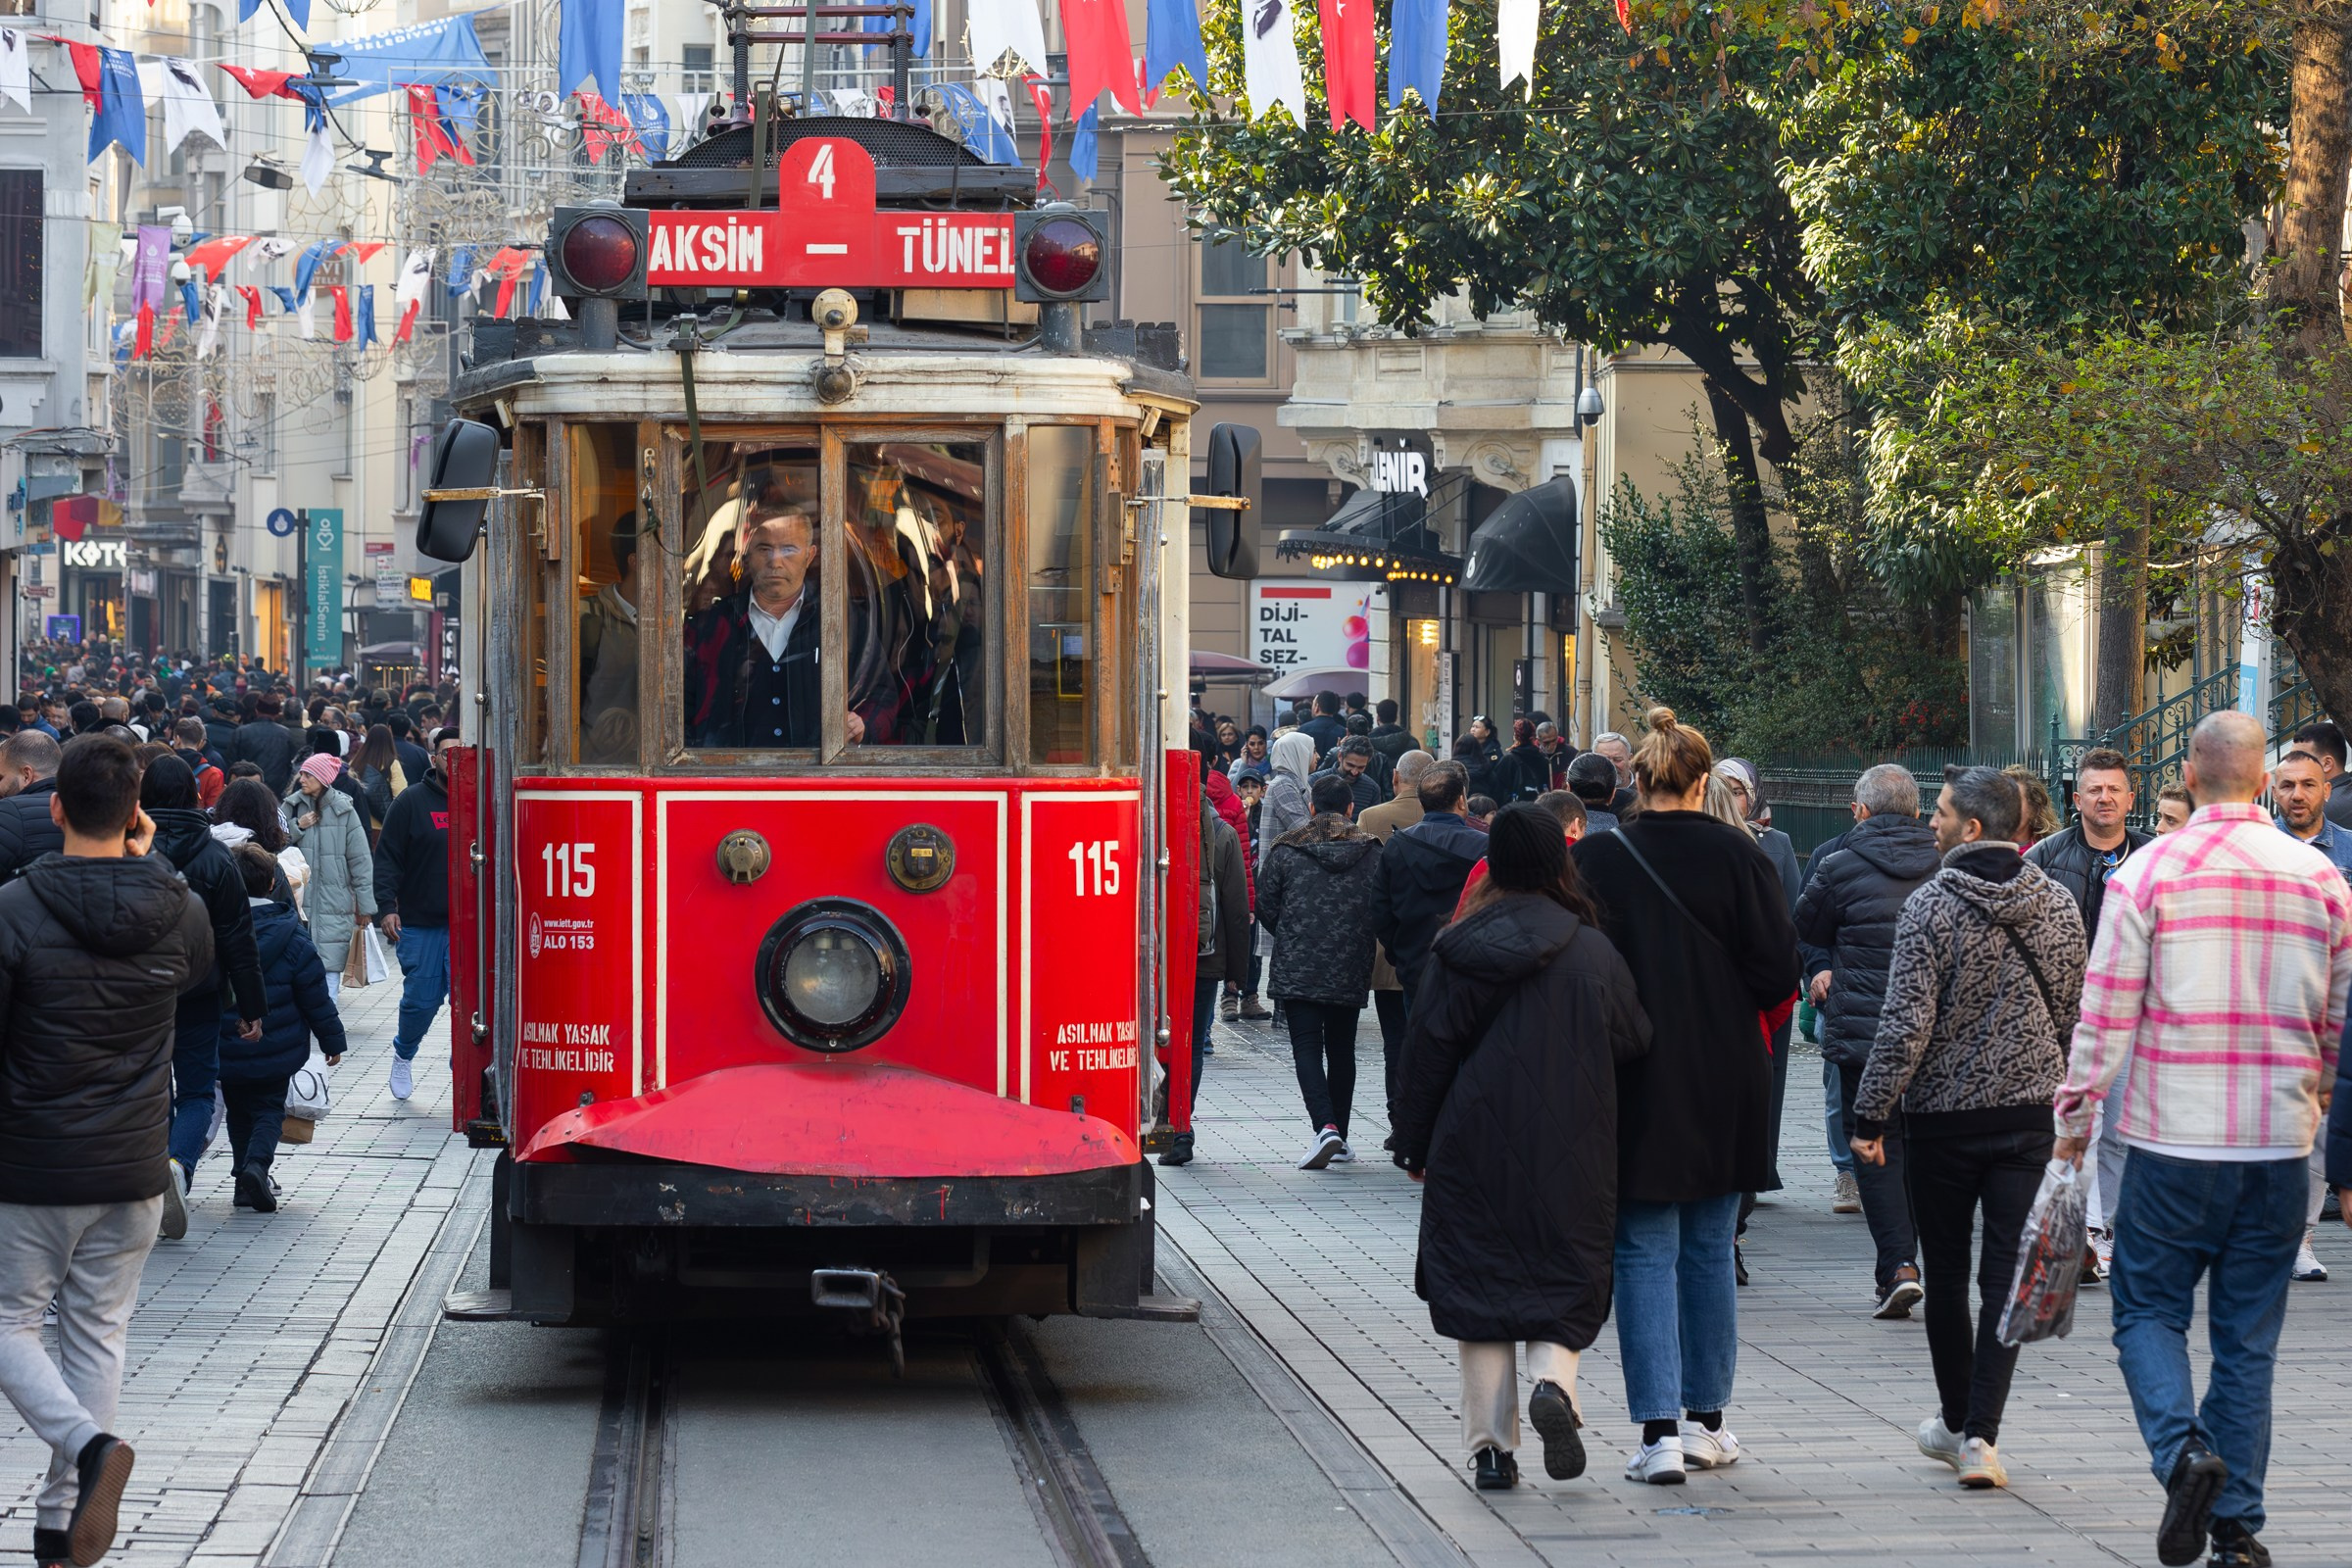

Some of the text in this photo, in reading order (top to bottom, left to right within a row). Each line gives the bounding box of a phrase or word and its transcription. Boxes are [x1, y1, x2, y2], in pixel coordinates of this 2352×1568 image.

[808, 144, 835, 199] 4
[648, 217, 762, 271] AKSİM
[1260, 602, 1309, 622] DİJİ-
[1259, 628, 1298, 643] TAL
[1259, 649, 1308, 664] SEZ-
[542, 843, 596, 898] 115
[1068, 840, 1120, 897] 115
[544, 919, 594, 930] www.iett.gov.tr
[544, 935, 595, 950] ALO 153
[523, 1022, 611, 1046] ASILMAK YASAK
[1056, 1022, 1113, 1045] ASILMAK
[531, 1047, 614, 1073] TEHLİKELİDİR
[1050, 1050, 1070, 1072] VE
